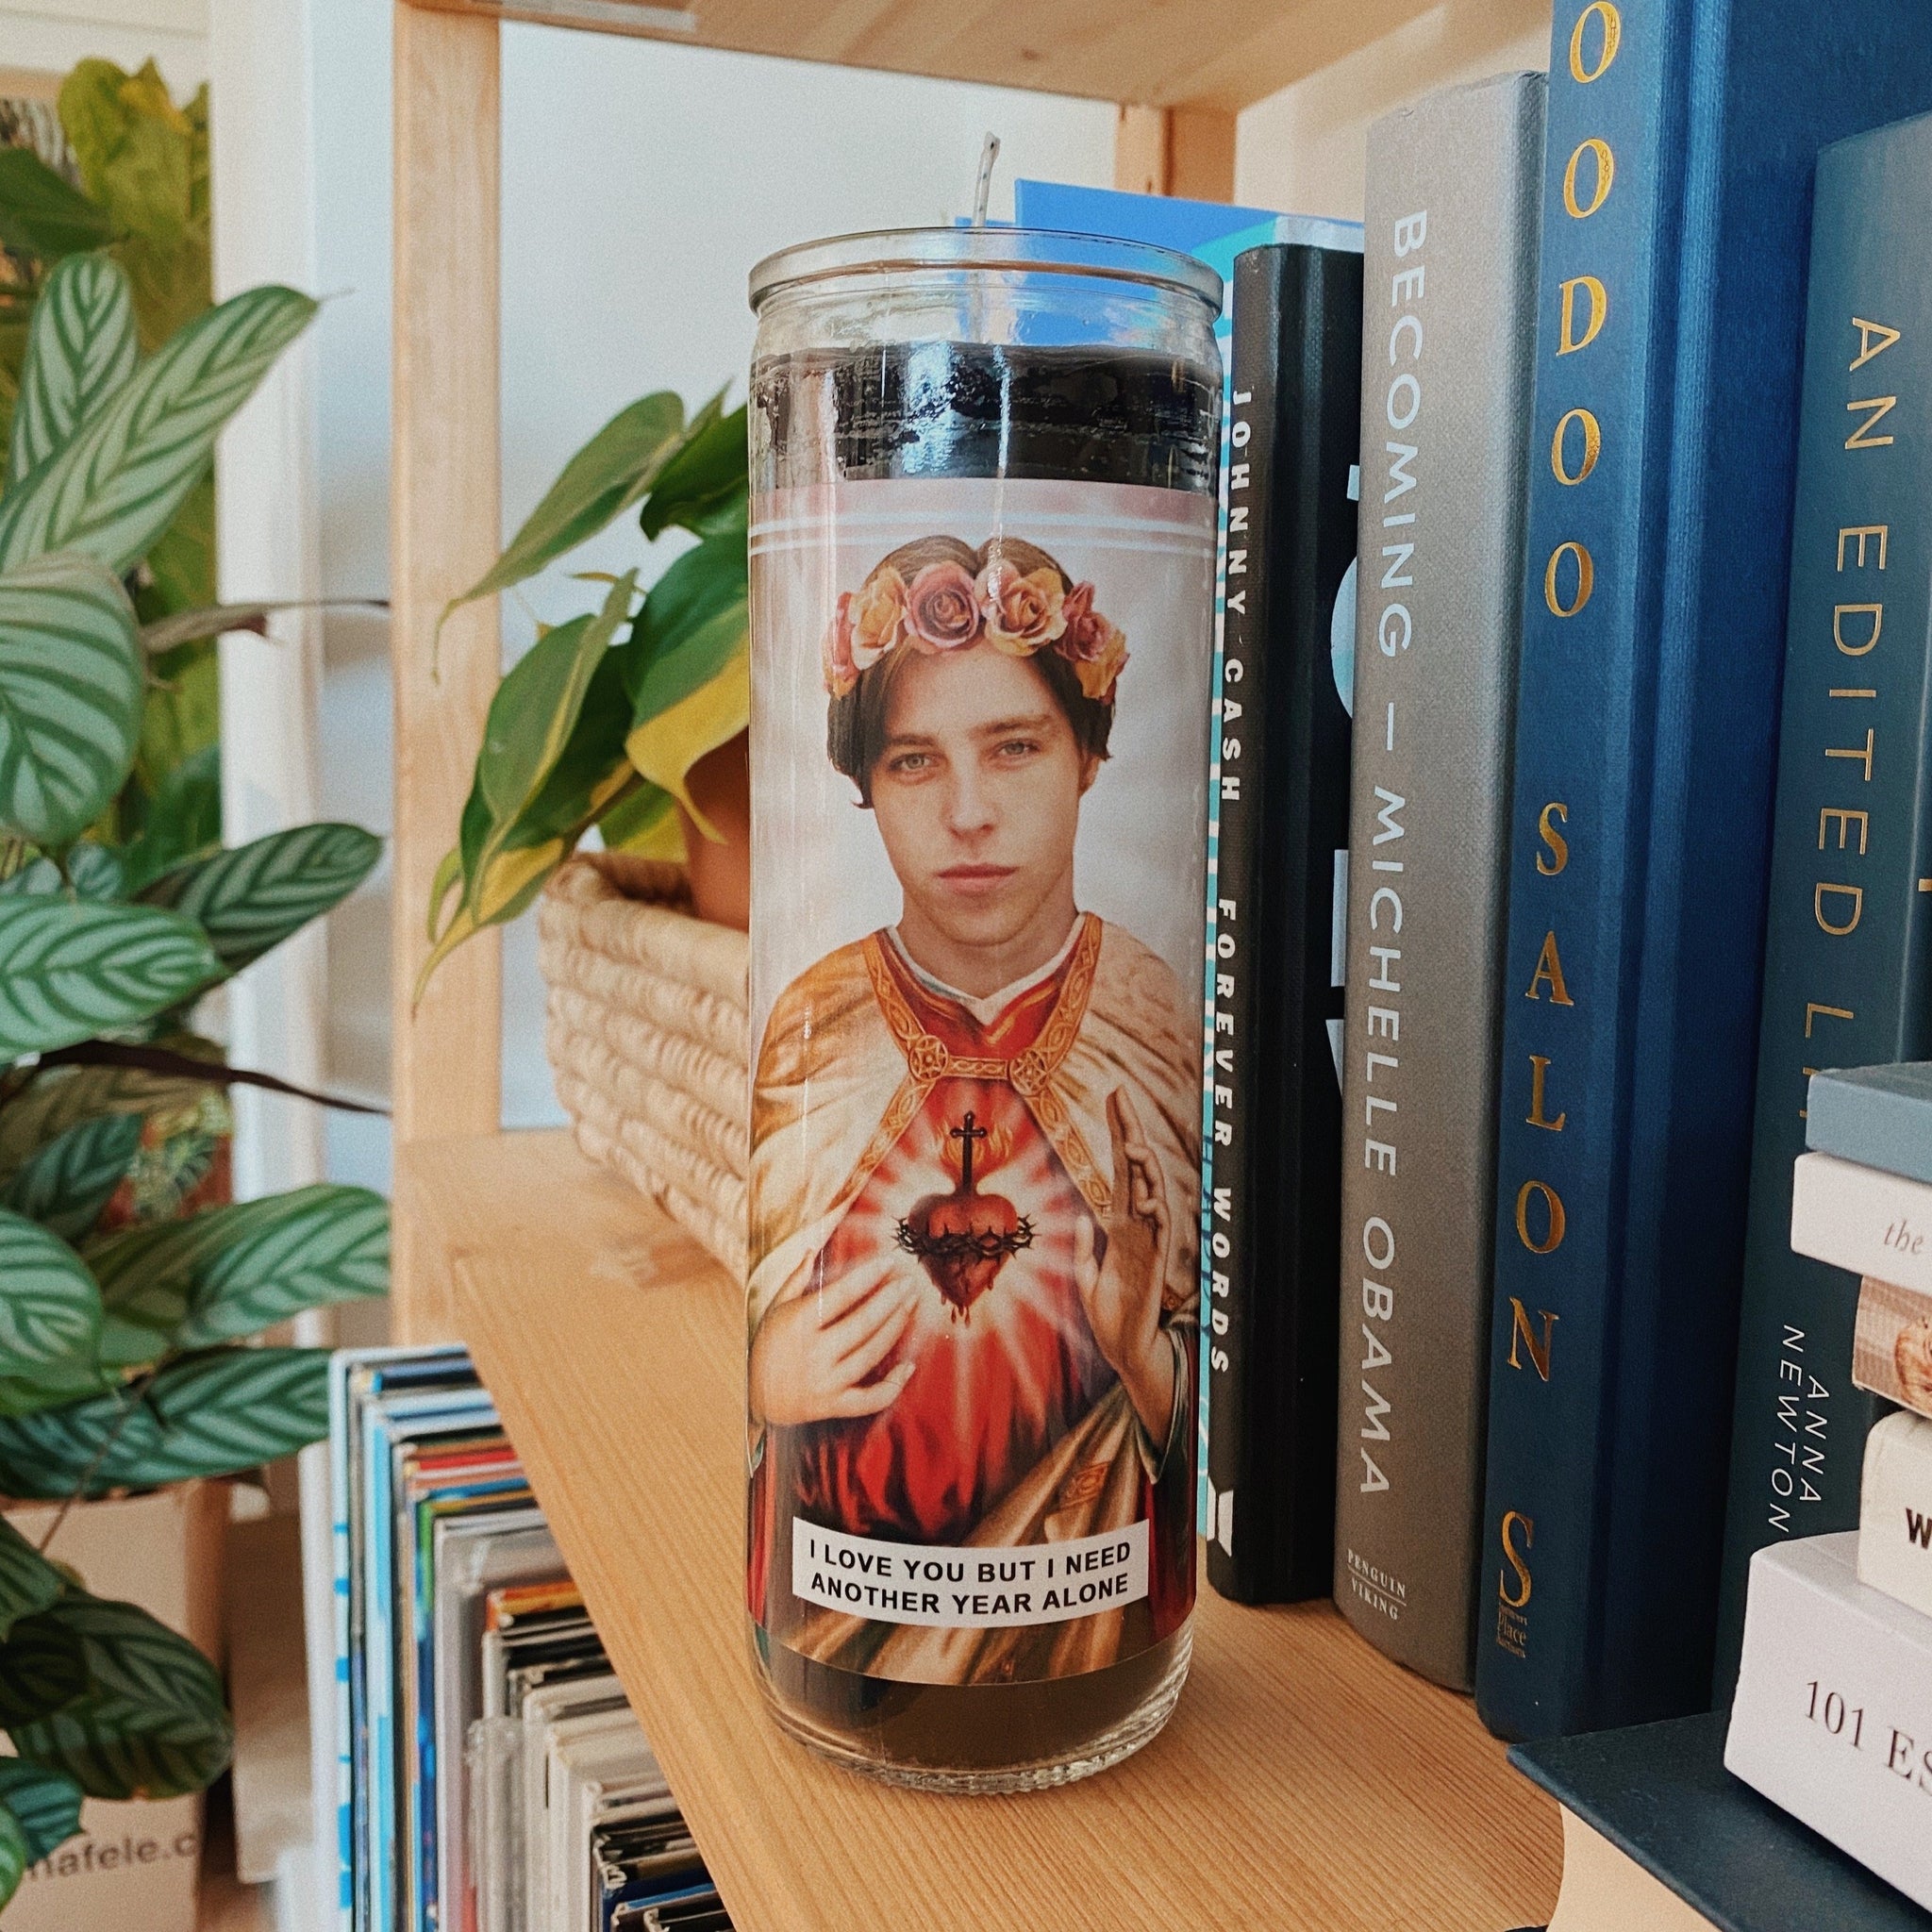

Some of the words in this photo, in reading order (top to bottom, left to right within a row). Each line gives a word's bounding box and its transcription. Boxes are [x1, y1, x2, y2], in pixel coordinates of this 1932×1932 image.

[1378, 209, 1427, 658] BECOMING
[1844, 316, 1901, 450] AN
[1227, 390, 1252, 615] JOHNNY
[1221, 658, 1244, 800] CASH
[1814, 525, 1889, 936] EDITED
[1215, 898, 1237, 1147] FOREVER
[1364, 784, 1407, 1176] MICHELLE
[1507, 802, 1574, 1382] SALON
[1210, 1187, 1232, 1373] WORDS
[1884, 1219, 1924, 1256] the
[1359, 1216, 1395, 1492] OBAMA
[1768, 1324, 1806, 1533] NEWTON
[1799, 1374, 1830, 1502] ANNA
[809, 1539, 815, 1558] I
[824, 1542, 892, 1577] LOVE
[903, 1558, 964, 1583] YOU
[977, 1560, 1037, 1584] BUT
[1047, 1557, 1054, 1578] I
[1066, 1541, 1132, 1574] NEED
[810, 1572, 941, 1614] ANOTHER
[951, 1593, 1033, 1615] YEAR
[1041, 1572, 1129, 1610] ALONE
[1347, 1547, 1407, 1599] PENGUIN
[1351, 1576, 1399, 1622] VIKING
[1805, 1680, 1864, 1752] 101
